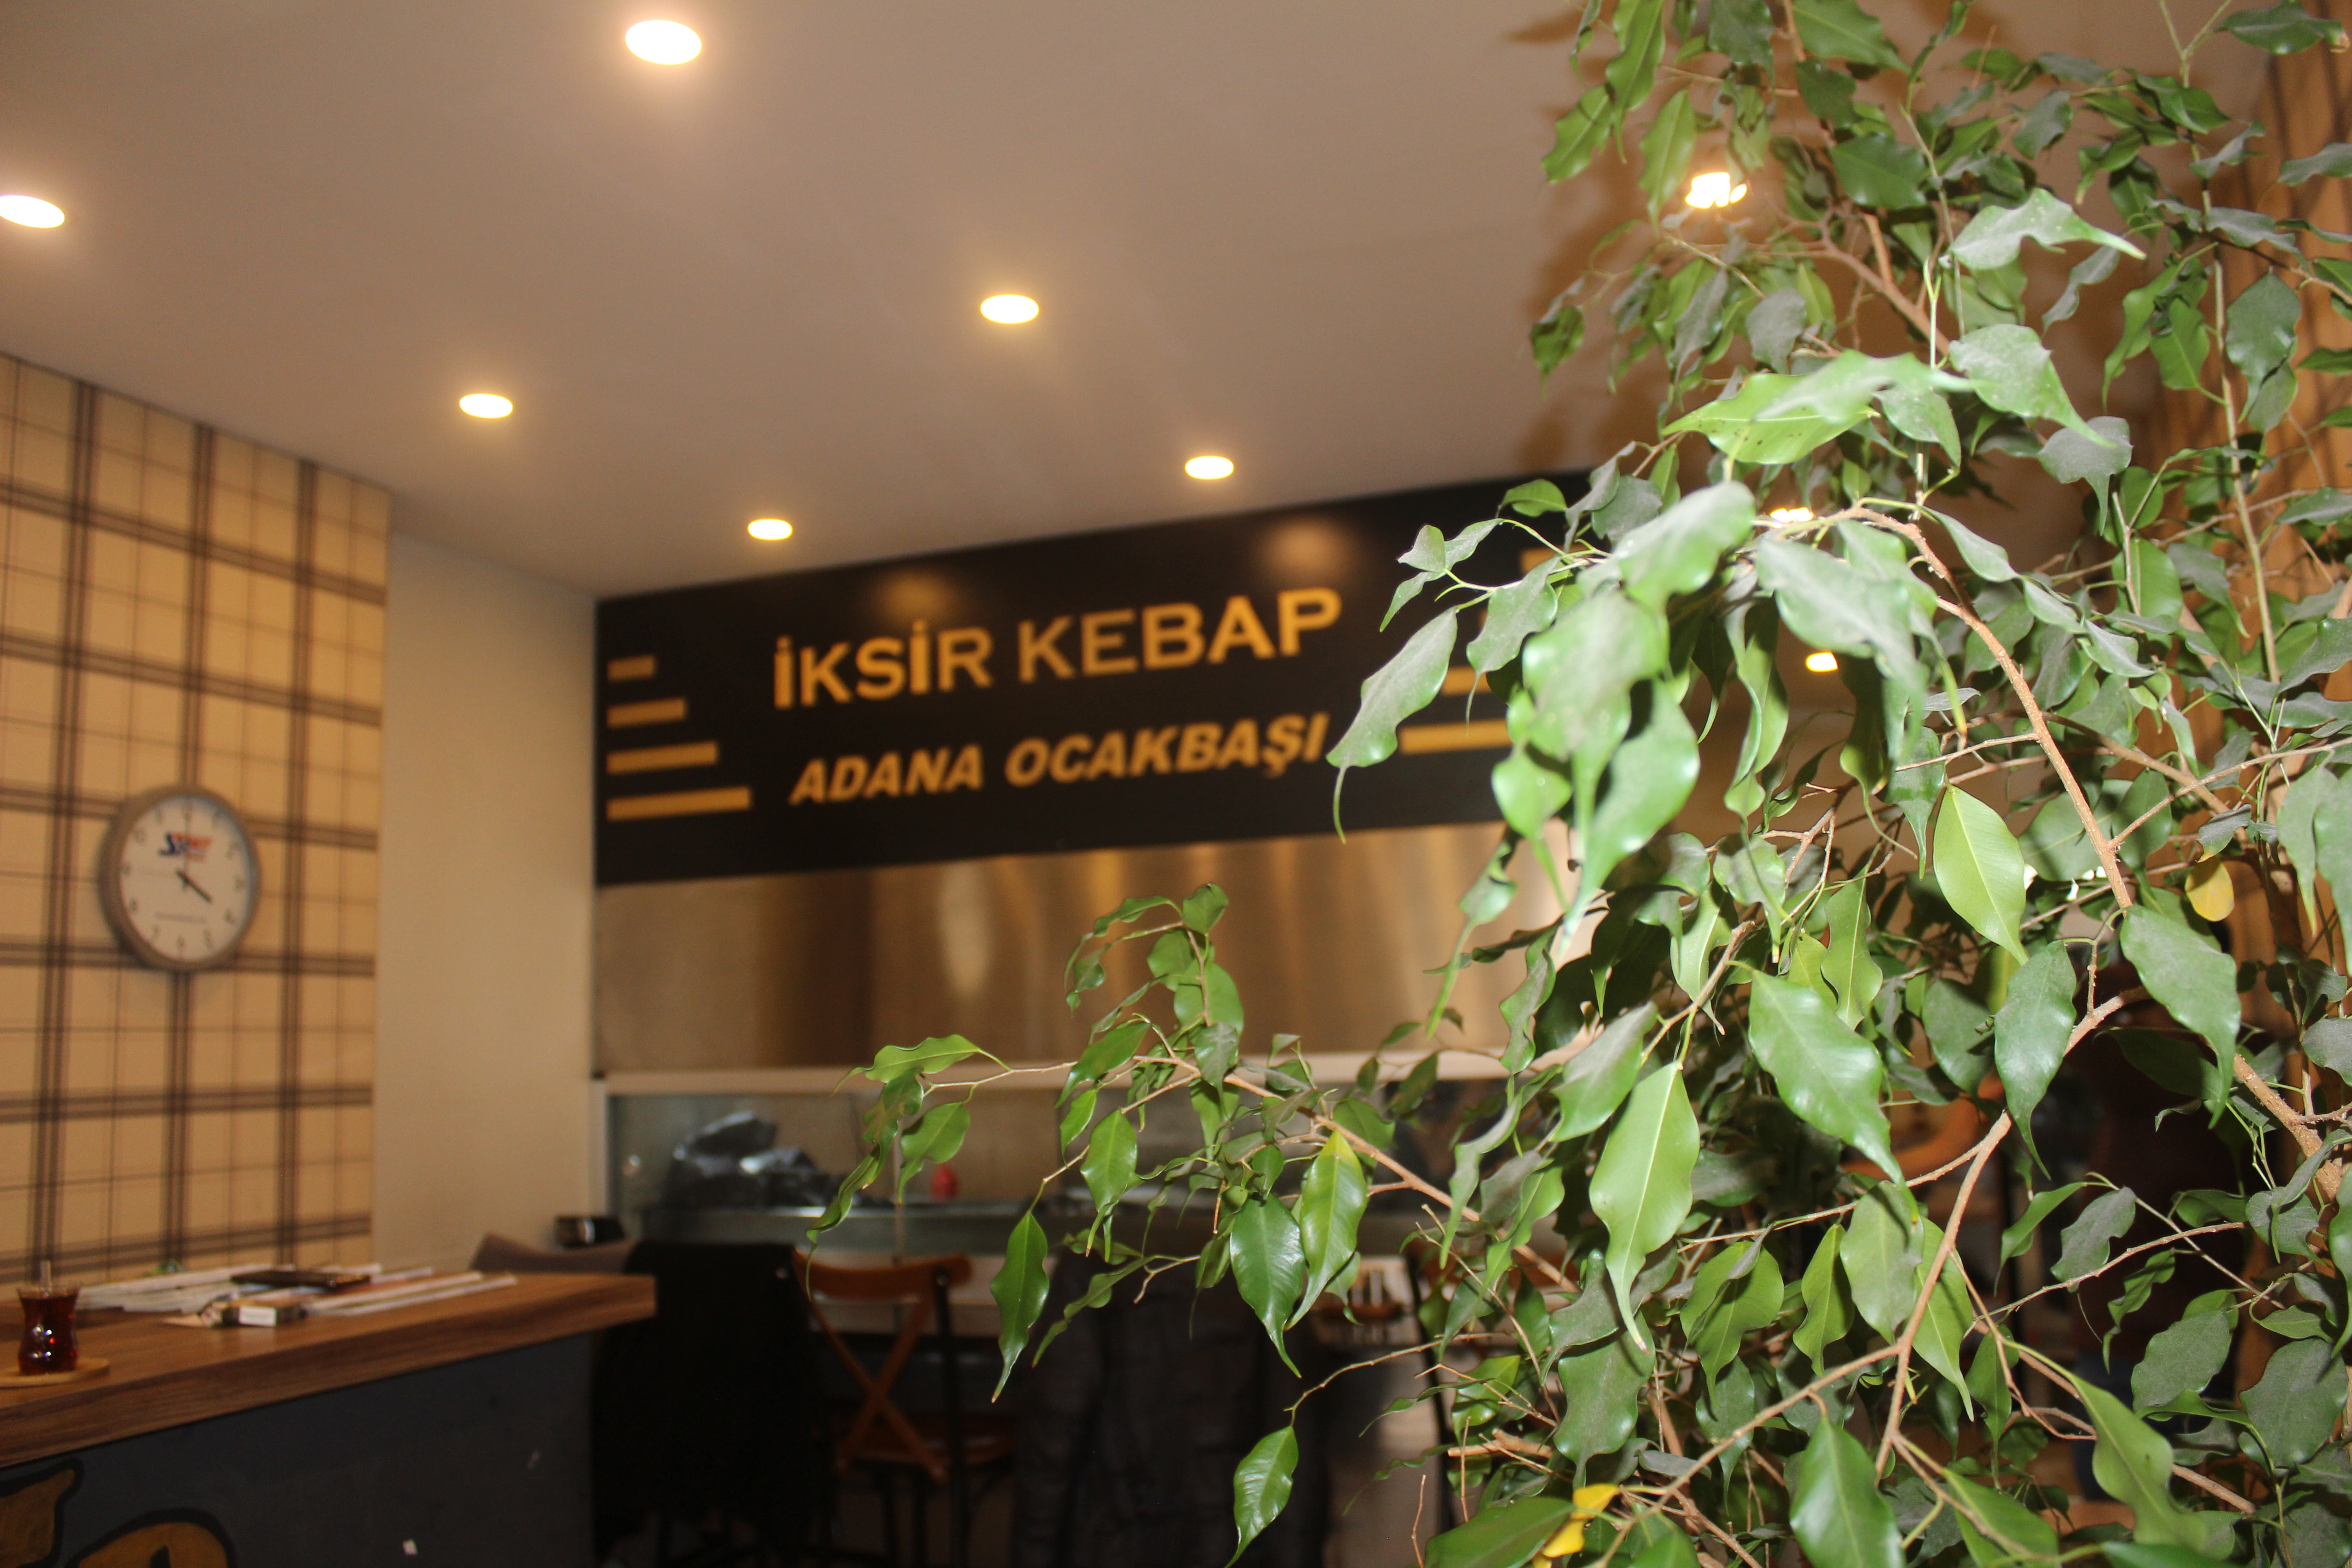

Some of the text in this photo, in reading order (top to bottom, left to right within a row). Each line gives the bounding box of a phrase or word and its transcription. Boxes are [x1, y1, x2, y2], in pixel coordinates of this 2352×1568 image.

[774, 587, 1343, 709] İKSİR KEBAP
[789, 712, 1330, 804] ADANA OCAKBAŞI
